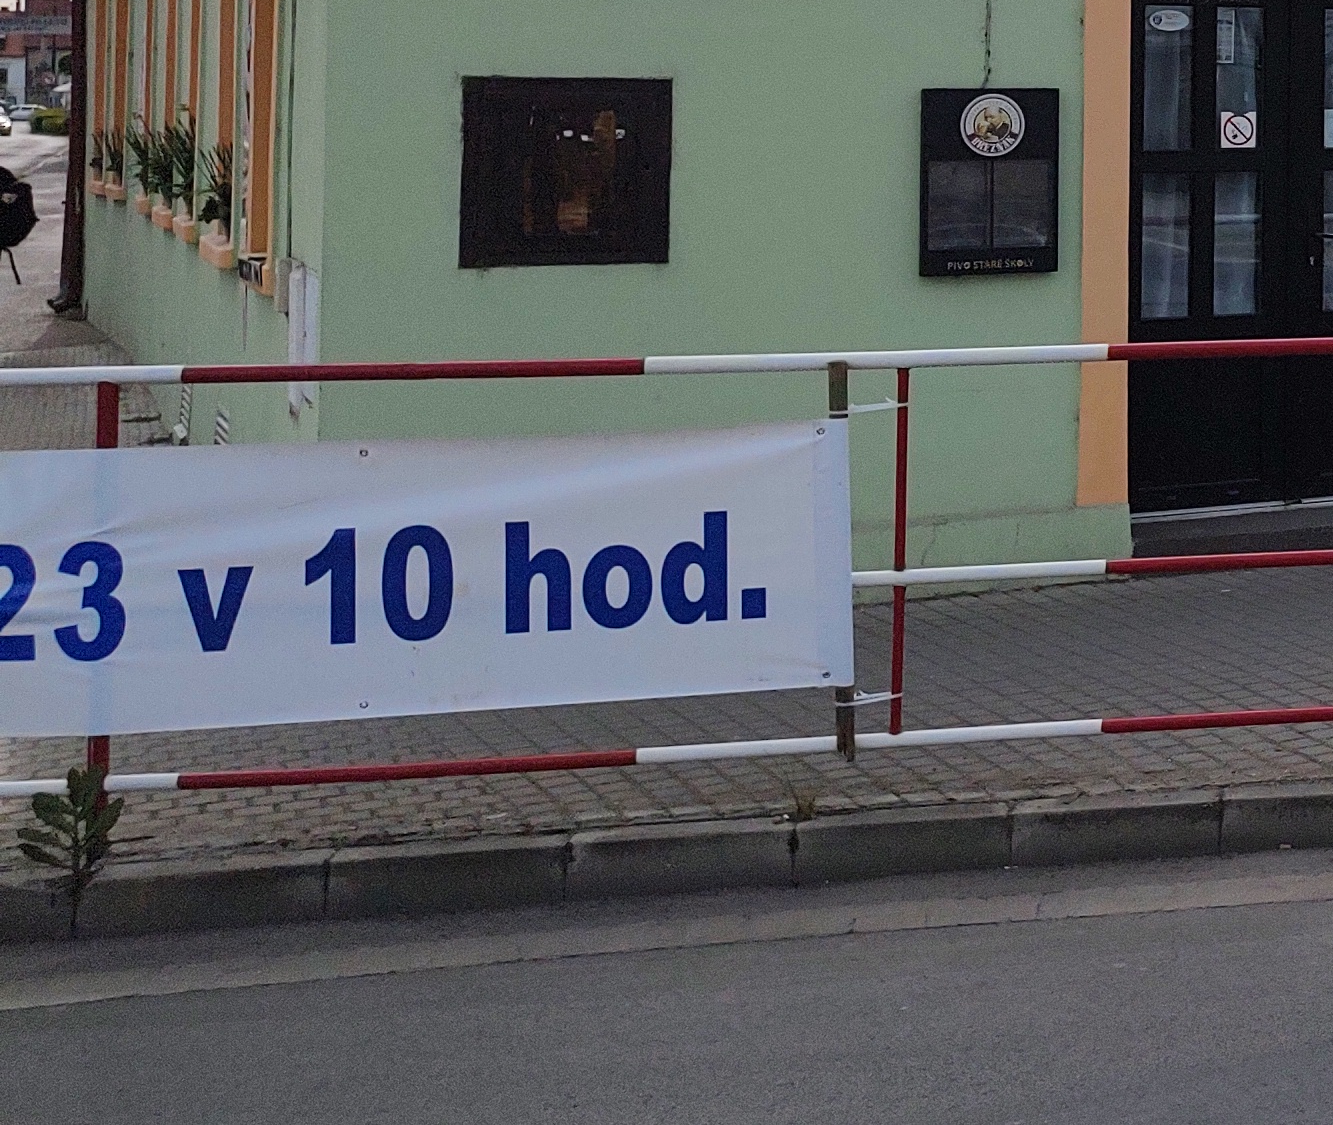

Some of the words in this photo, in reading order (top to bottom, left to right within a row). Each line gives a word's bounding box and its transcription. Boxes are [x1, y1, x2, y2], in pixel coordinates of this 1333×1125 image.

[947, 261, 971, 271] PIVO
[178, 566, 253, 652] v
[304, 524, 454, 646] 10
[505, 511, 767, 634] hod.
